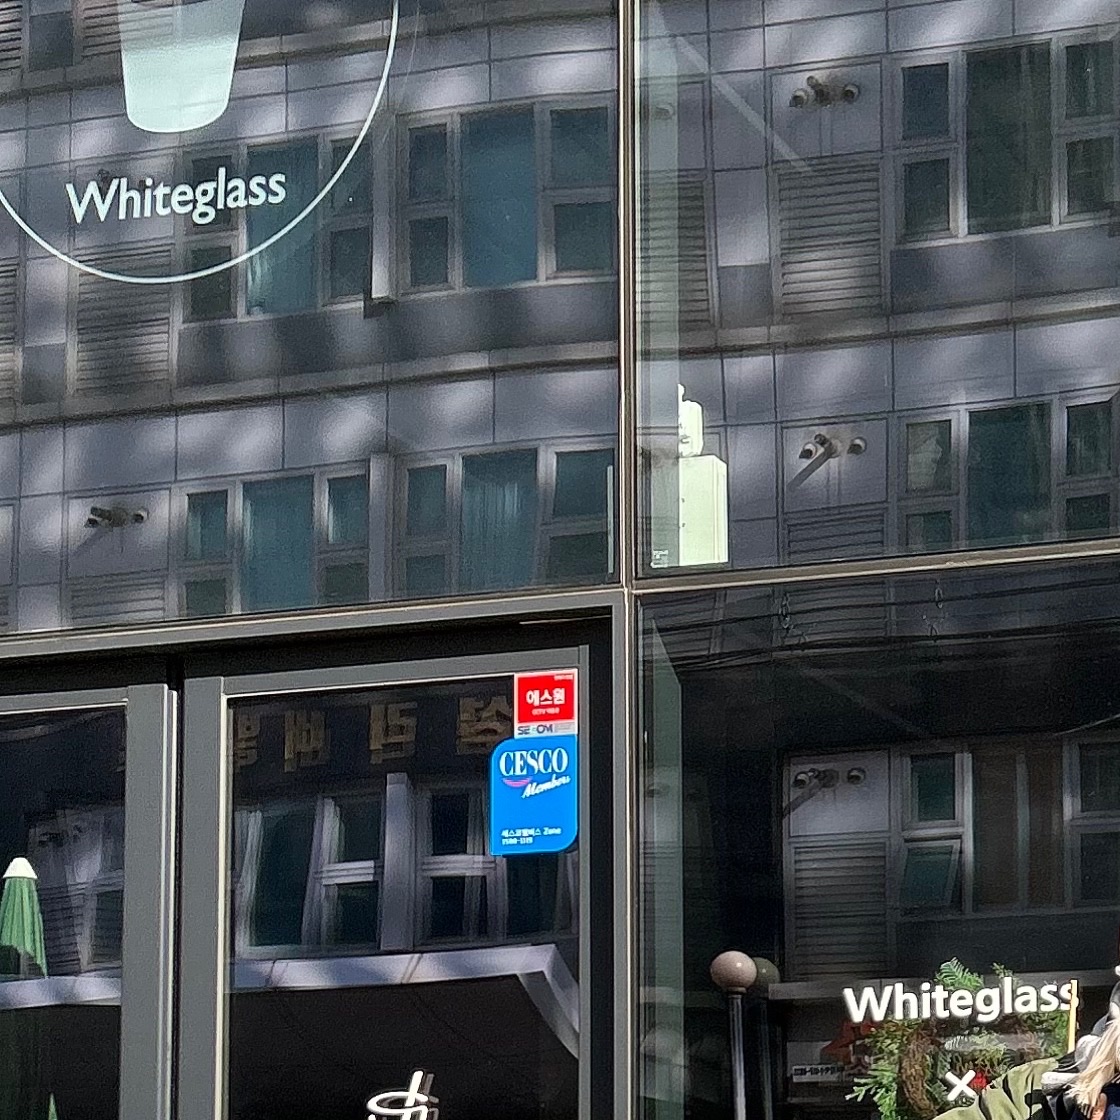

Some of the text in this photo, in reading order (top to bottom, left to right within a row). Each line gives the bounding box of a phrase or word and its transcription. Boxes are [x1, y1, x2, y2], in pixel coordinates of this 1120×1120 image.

[66, 167, 287, 225] Whiteglass
[525, 688, 566, 706] 에스원
[499, 748, 569, 776] CESCO
[842, 976, 1080, 1024] Whiteglass
